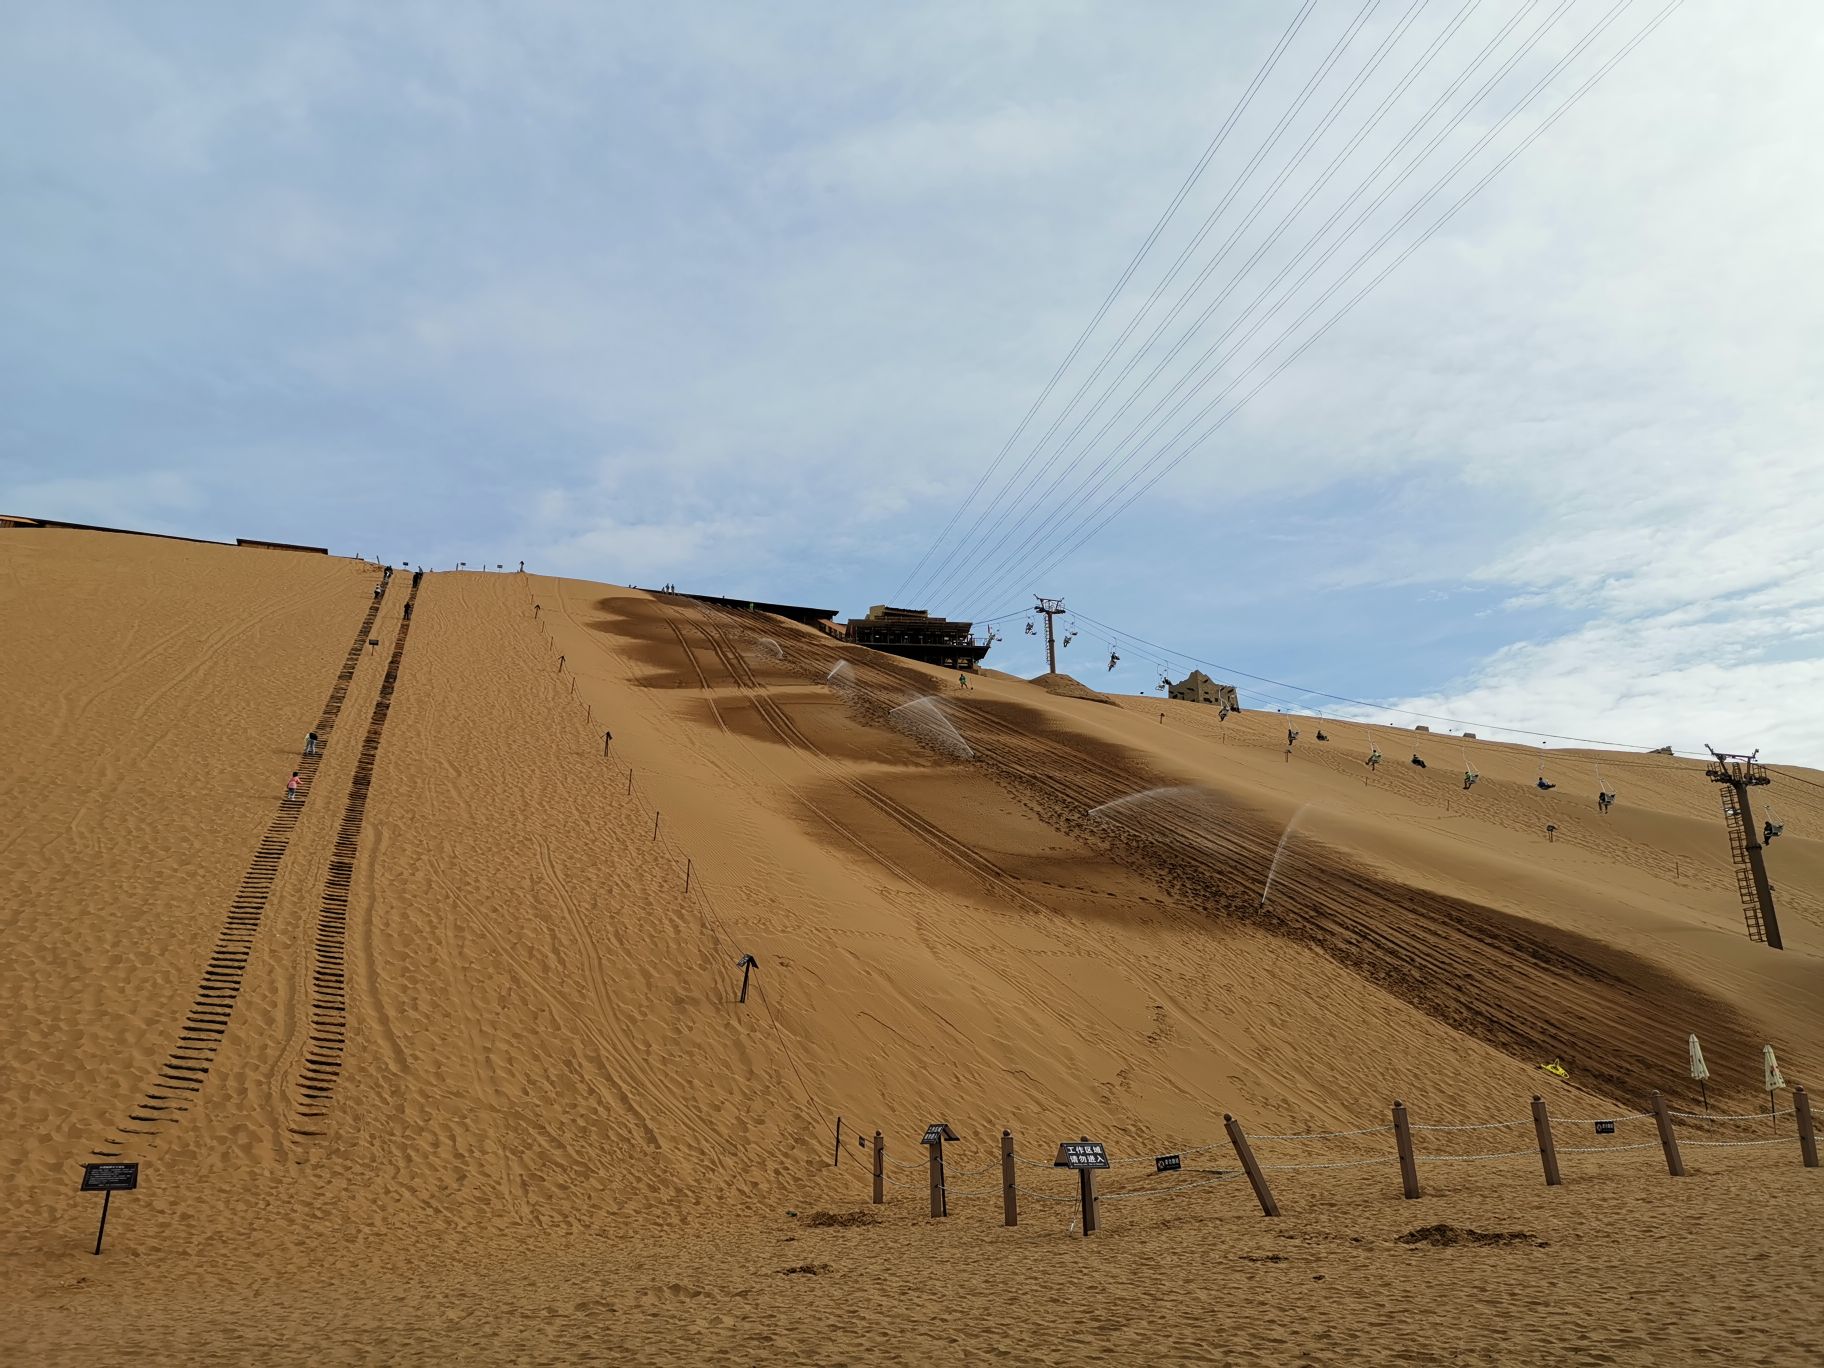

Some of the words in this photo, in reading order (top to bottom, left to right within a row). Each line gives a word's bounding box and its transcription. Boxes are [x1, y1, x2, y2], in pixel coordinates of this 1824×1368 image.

[1067, 1146, 1102, 1154] 工作区域
[1069, 1155, 1105, 1163] 请勿进入
